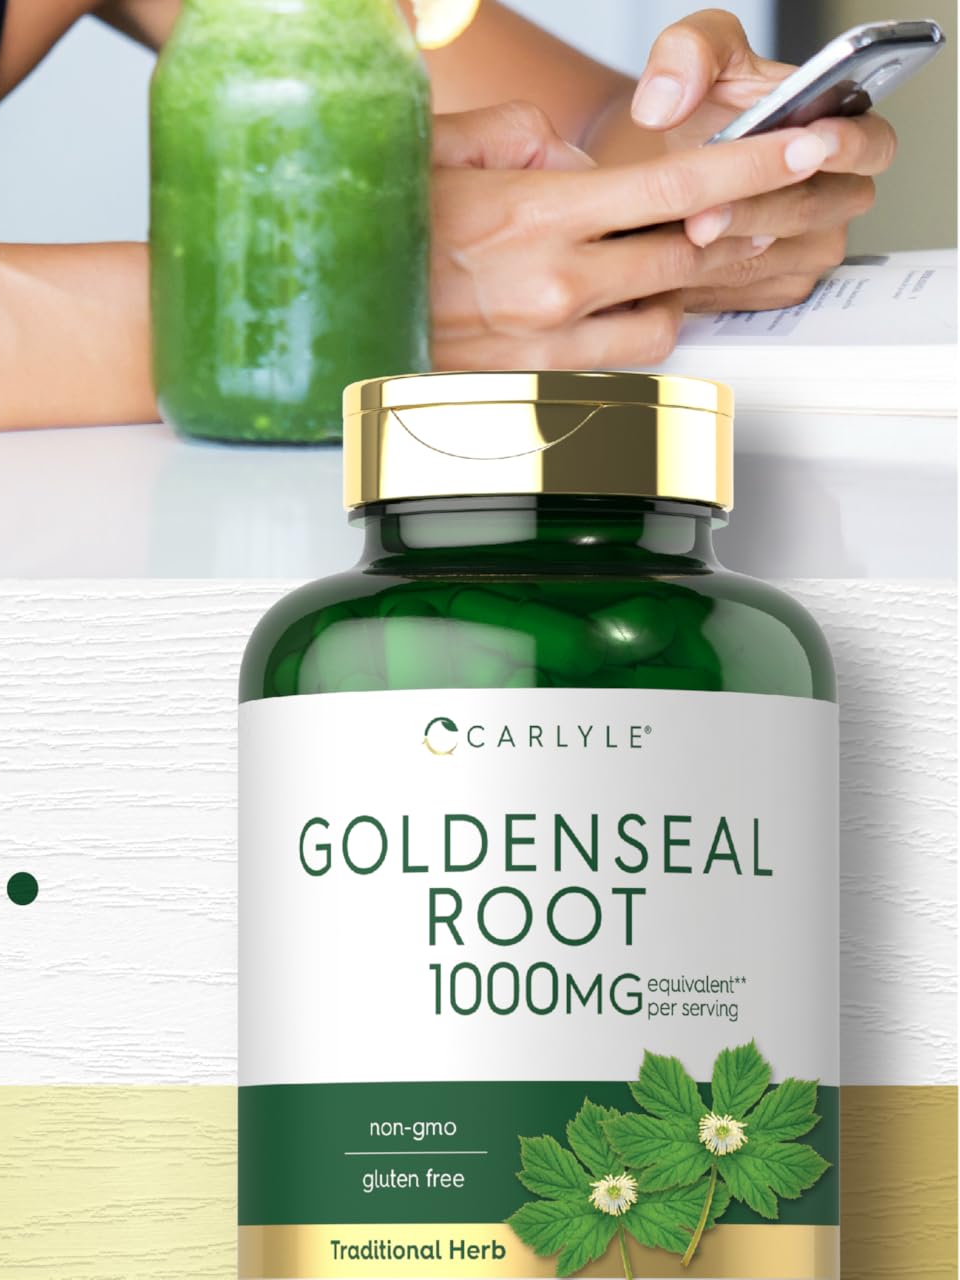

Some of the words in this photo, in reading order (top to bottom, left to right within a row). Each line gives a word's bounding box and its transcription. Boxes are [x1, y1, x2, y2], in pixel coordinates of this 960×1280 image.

[298, 812, 775, 878] GOLDENSEAL
[428, 885, 648, 948] ROOT
[428, 960, 644, 1017] 1000MG
[647, 1001, 678, 1020] per
[681, 999, 739, 1023] serving
[369, 1121, 457, 1142] non-gmo
[362, 1168, 420, 1194] gluten
[425, 1167, 465, 1188] free
[329, 1239, 443, 1261] Traditional
[448, 1239, 507, 1261] Herb
